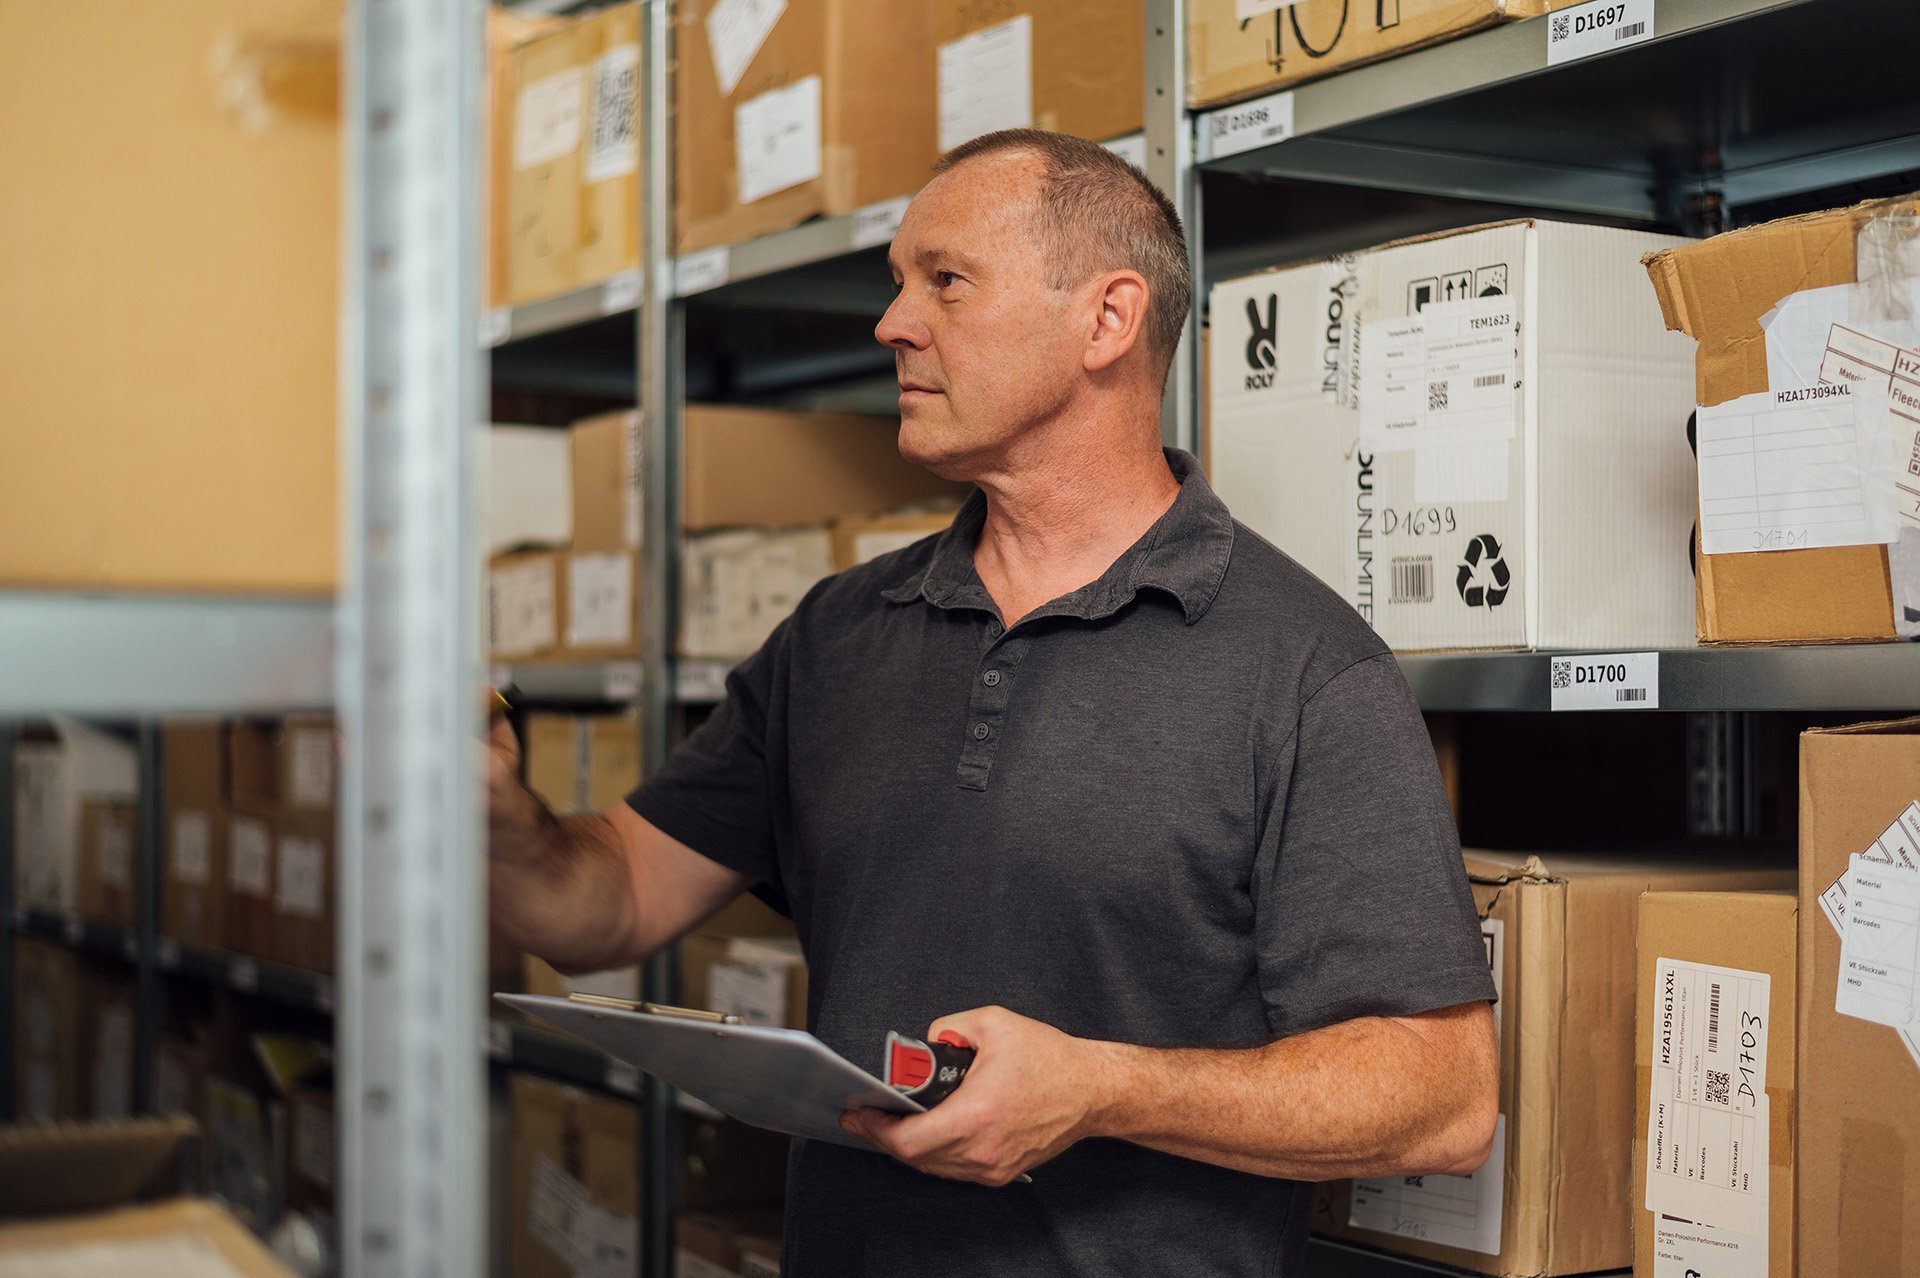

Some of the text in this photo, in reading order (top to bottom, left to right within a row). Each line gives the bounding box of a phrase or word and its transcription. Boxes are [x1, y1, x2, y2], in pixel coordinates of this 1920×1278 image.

[1575, 4, 1625, 34] D1697
[1469, 314, 1510, 330] TEM1623
[1245, 372, 1275, 391] ROLY
[1777, 384, 1851, 404] HZA173094XL
[1380, 506, 1457, 536] D1699
[1752, 529, 1808, 549] D1701
[1576, 664, 1626, 684] D1700
[1856, 878, 1882, 889] Material
[1852, 916, 1881, 930] Barcodes
[1848, 961, 1888, 977] VE Stückzahl
[1846, 977, 1862, 987] MHD
[1662, 970, 1675, 1064] HZA19561XXL
[1737, 1010, 1762, 1108] D1703
[1656, 1130, 1664, 1170] Schaeffler
[1672, 1144, 1680, 1174] Material
[1688, 1168, 1694, 1178] VE
[1731, 1178, 1737, 1188] VE
[1666, 1238, 1675, 1246] 2XL
[1697, 1237, 1727, 1248] Performance
